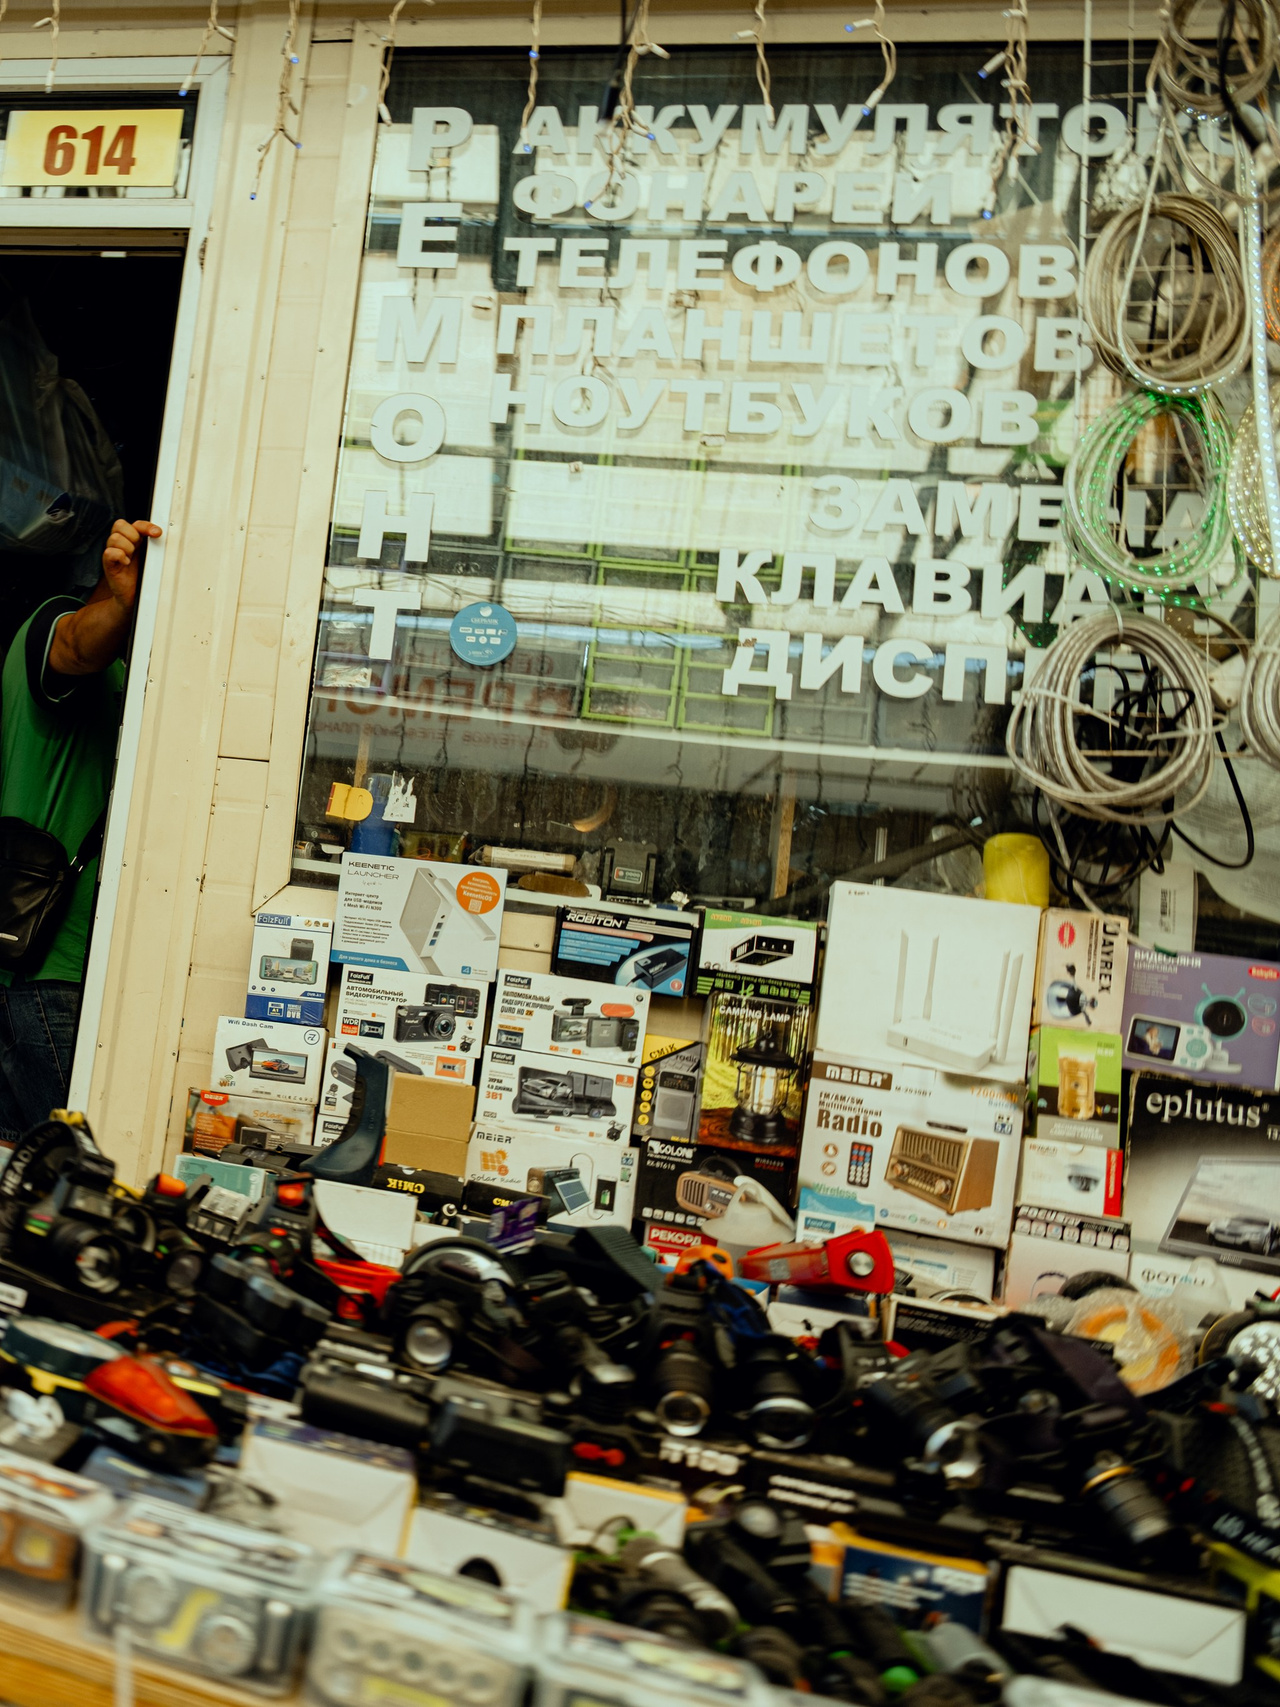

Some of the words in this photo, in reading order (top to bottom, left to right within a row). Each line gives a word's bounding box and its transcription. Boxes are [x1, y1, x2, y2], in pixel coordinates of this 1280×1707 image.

[42, 124, 138, 177] 614
[513, 160, 951, 224] ФОНАРЕЙ
[503, 237, 1077, 298] ТЕЛЕФОНОВ
[497, 304, 1094, 372] ПЛАНШЕТОВ
[489, 374, 1040, 445] НОУТБУКОВ
[347, 870, 400, 880] LAUNCHER
[348, 861, 395, 871] KEENETIC
[566, 912, 622, 928] ROBITON
[345, 991, 408, 1003] ВИДЕОРЕГИСТРАТОР
[346, 985, 404, 997] АВТОМОБИЛЬНЫЙ
[241, 1019, 257, 1027] Dash
[719, 1005, 762, 1019] CAMPING
[765, 1012, 791, 1023] LAMP
[819, 1100, 882, 1117] Multifunctional
[1146, 1089, 1261, 1128] eplutus
[817, 1108, 882, 1138] Radio
[470, 1173, 497, 1182] Solar
[812, 1182, 857, 1200] Wireless
